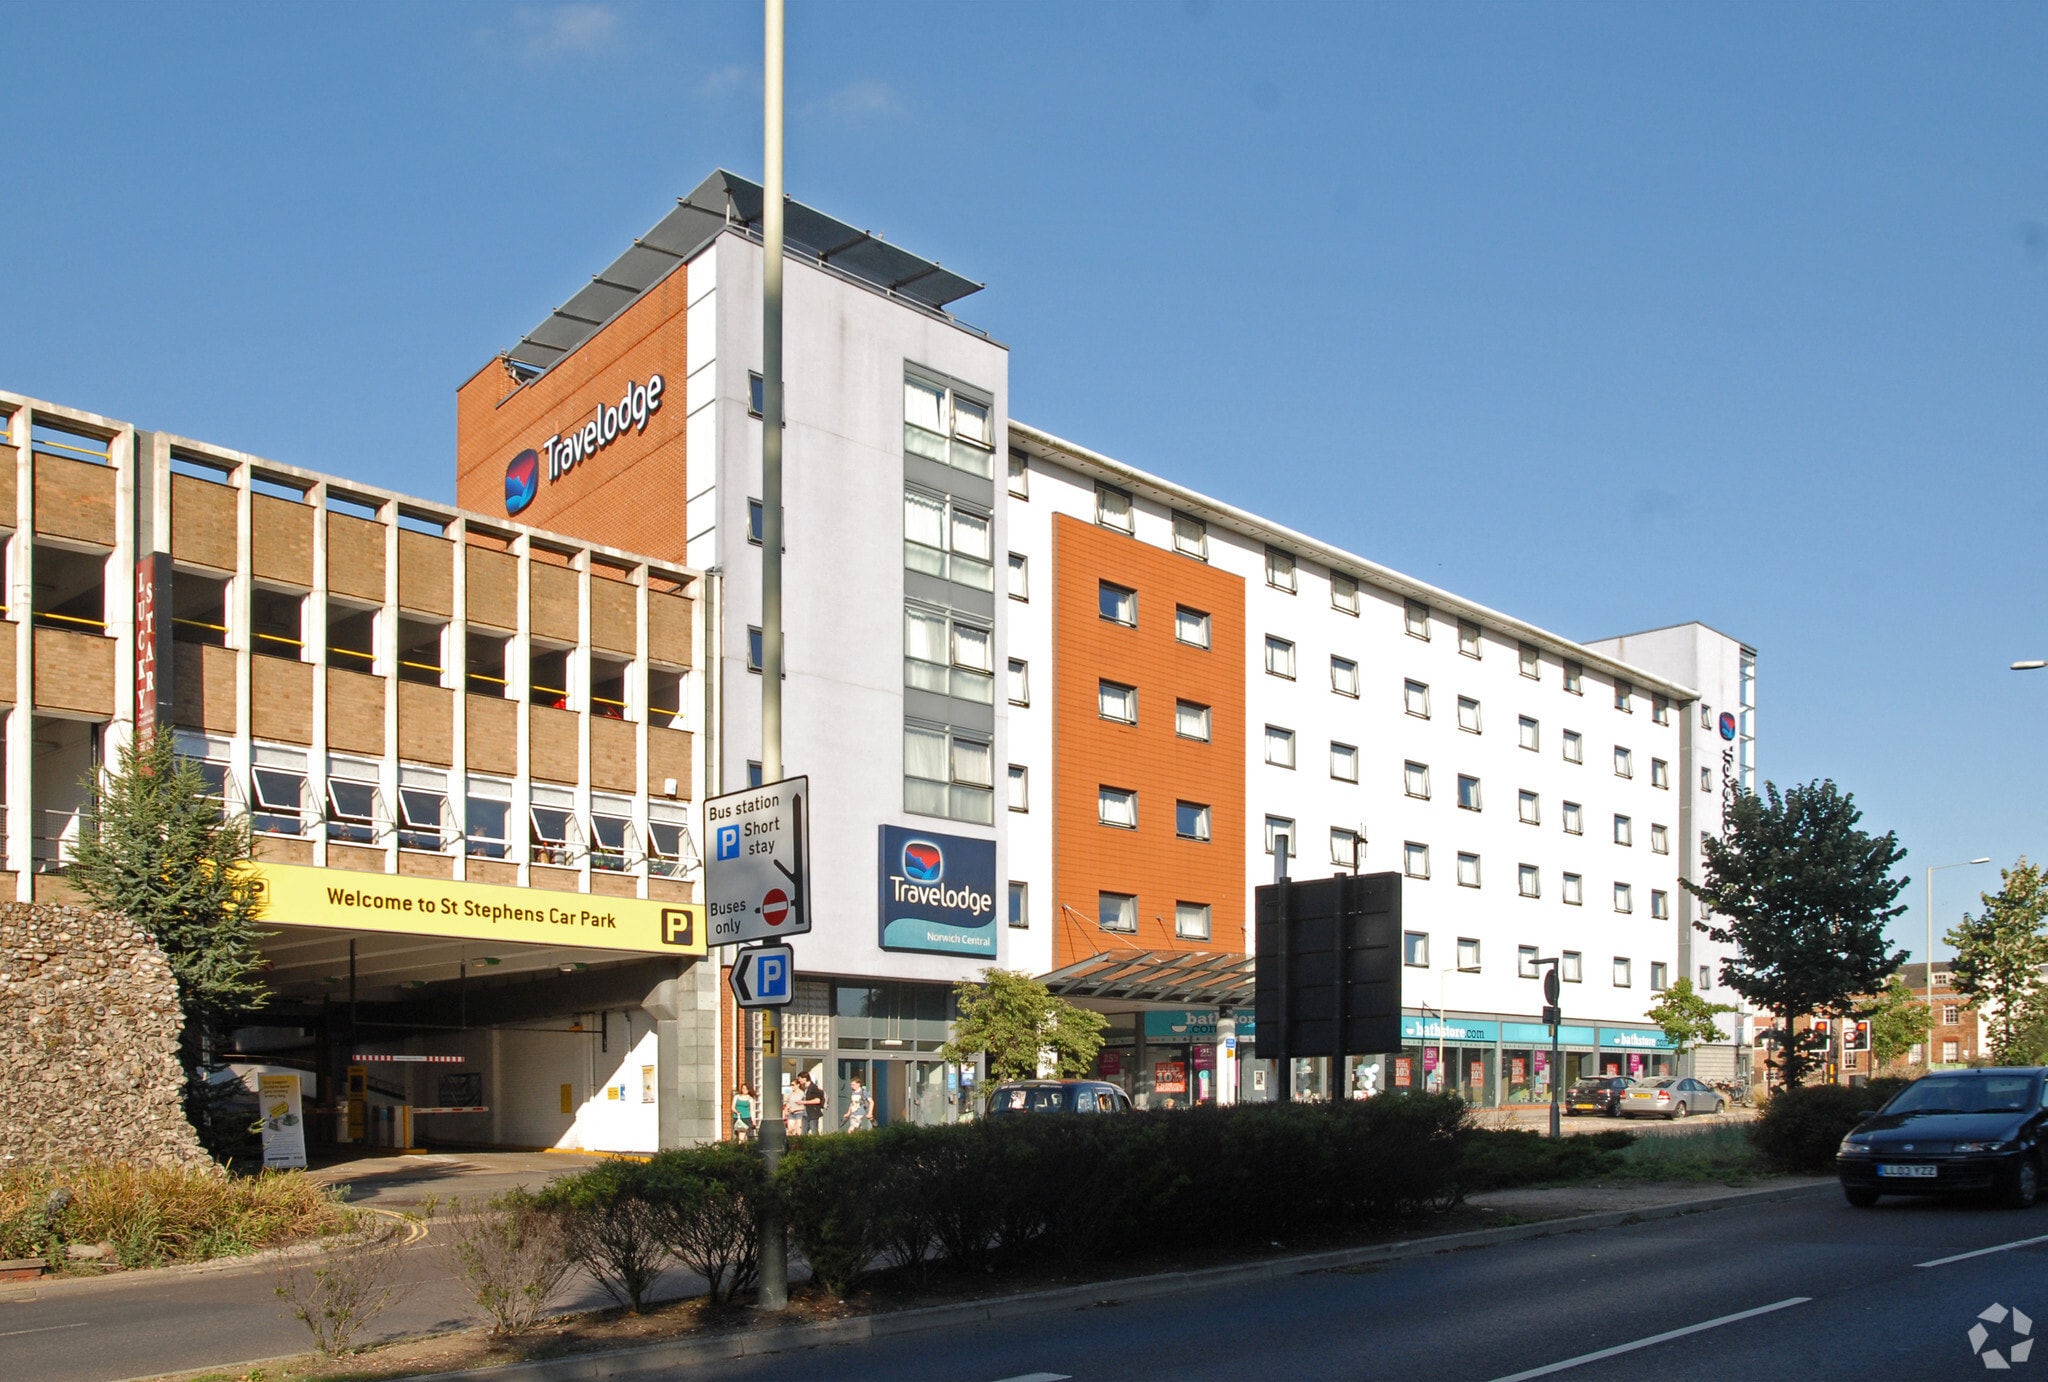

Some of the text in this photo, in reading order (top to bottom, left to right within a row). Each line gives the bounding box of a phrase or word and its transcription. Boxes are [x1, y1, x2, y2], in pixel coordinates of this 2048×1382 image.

[543, 374, 663, 482] Travelodge
[138, 572, 146, 710] LUCKY
[146, 581, 154, 692] STAR
[709, 795, 779, 822] Bus station
[744, 817, 780, 836] Short
[722, 829, 775, 857] P stay
[326, 887, 617, 928] Welcome to St Stephens Car Park
[710, 901, 746, 916] Buses
[889, 875, 992, 916] Travelodge
[666, 911, 688, 942] P
[716, 918, 741, 934] only
[926, 931, 991, 947] Norwich Central
[763, 959, 782, 993] P
[1416, 1022, 1485, 1039] bathstore.com
[1157, 1072, 1183, 1083] 10%
